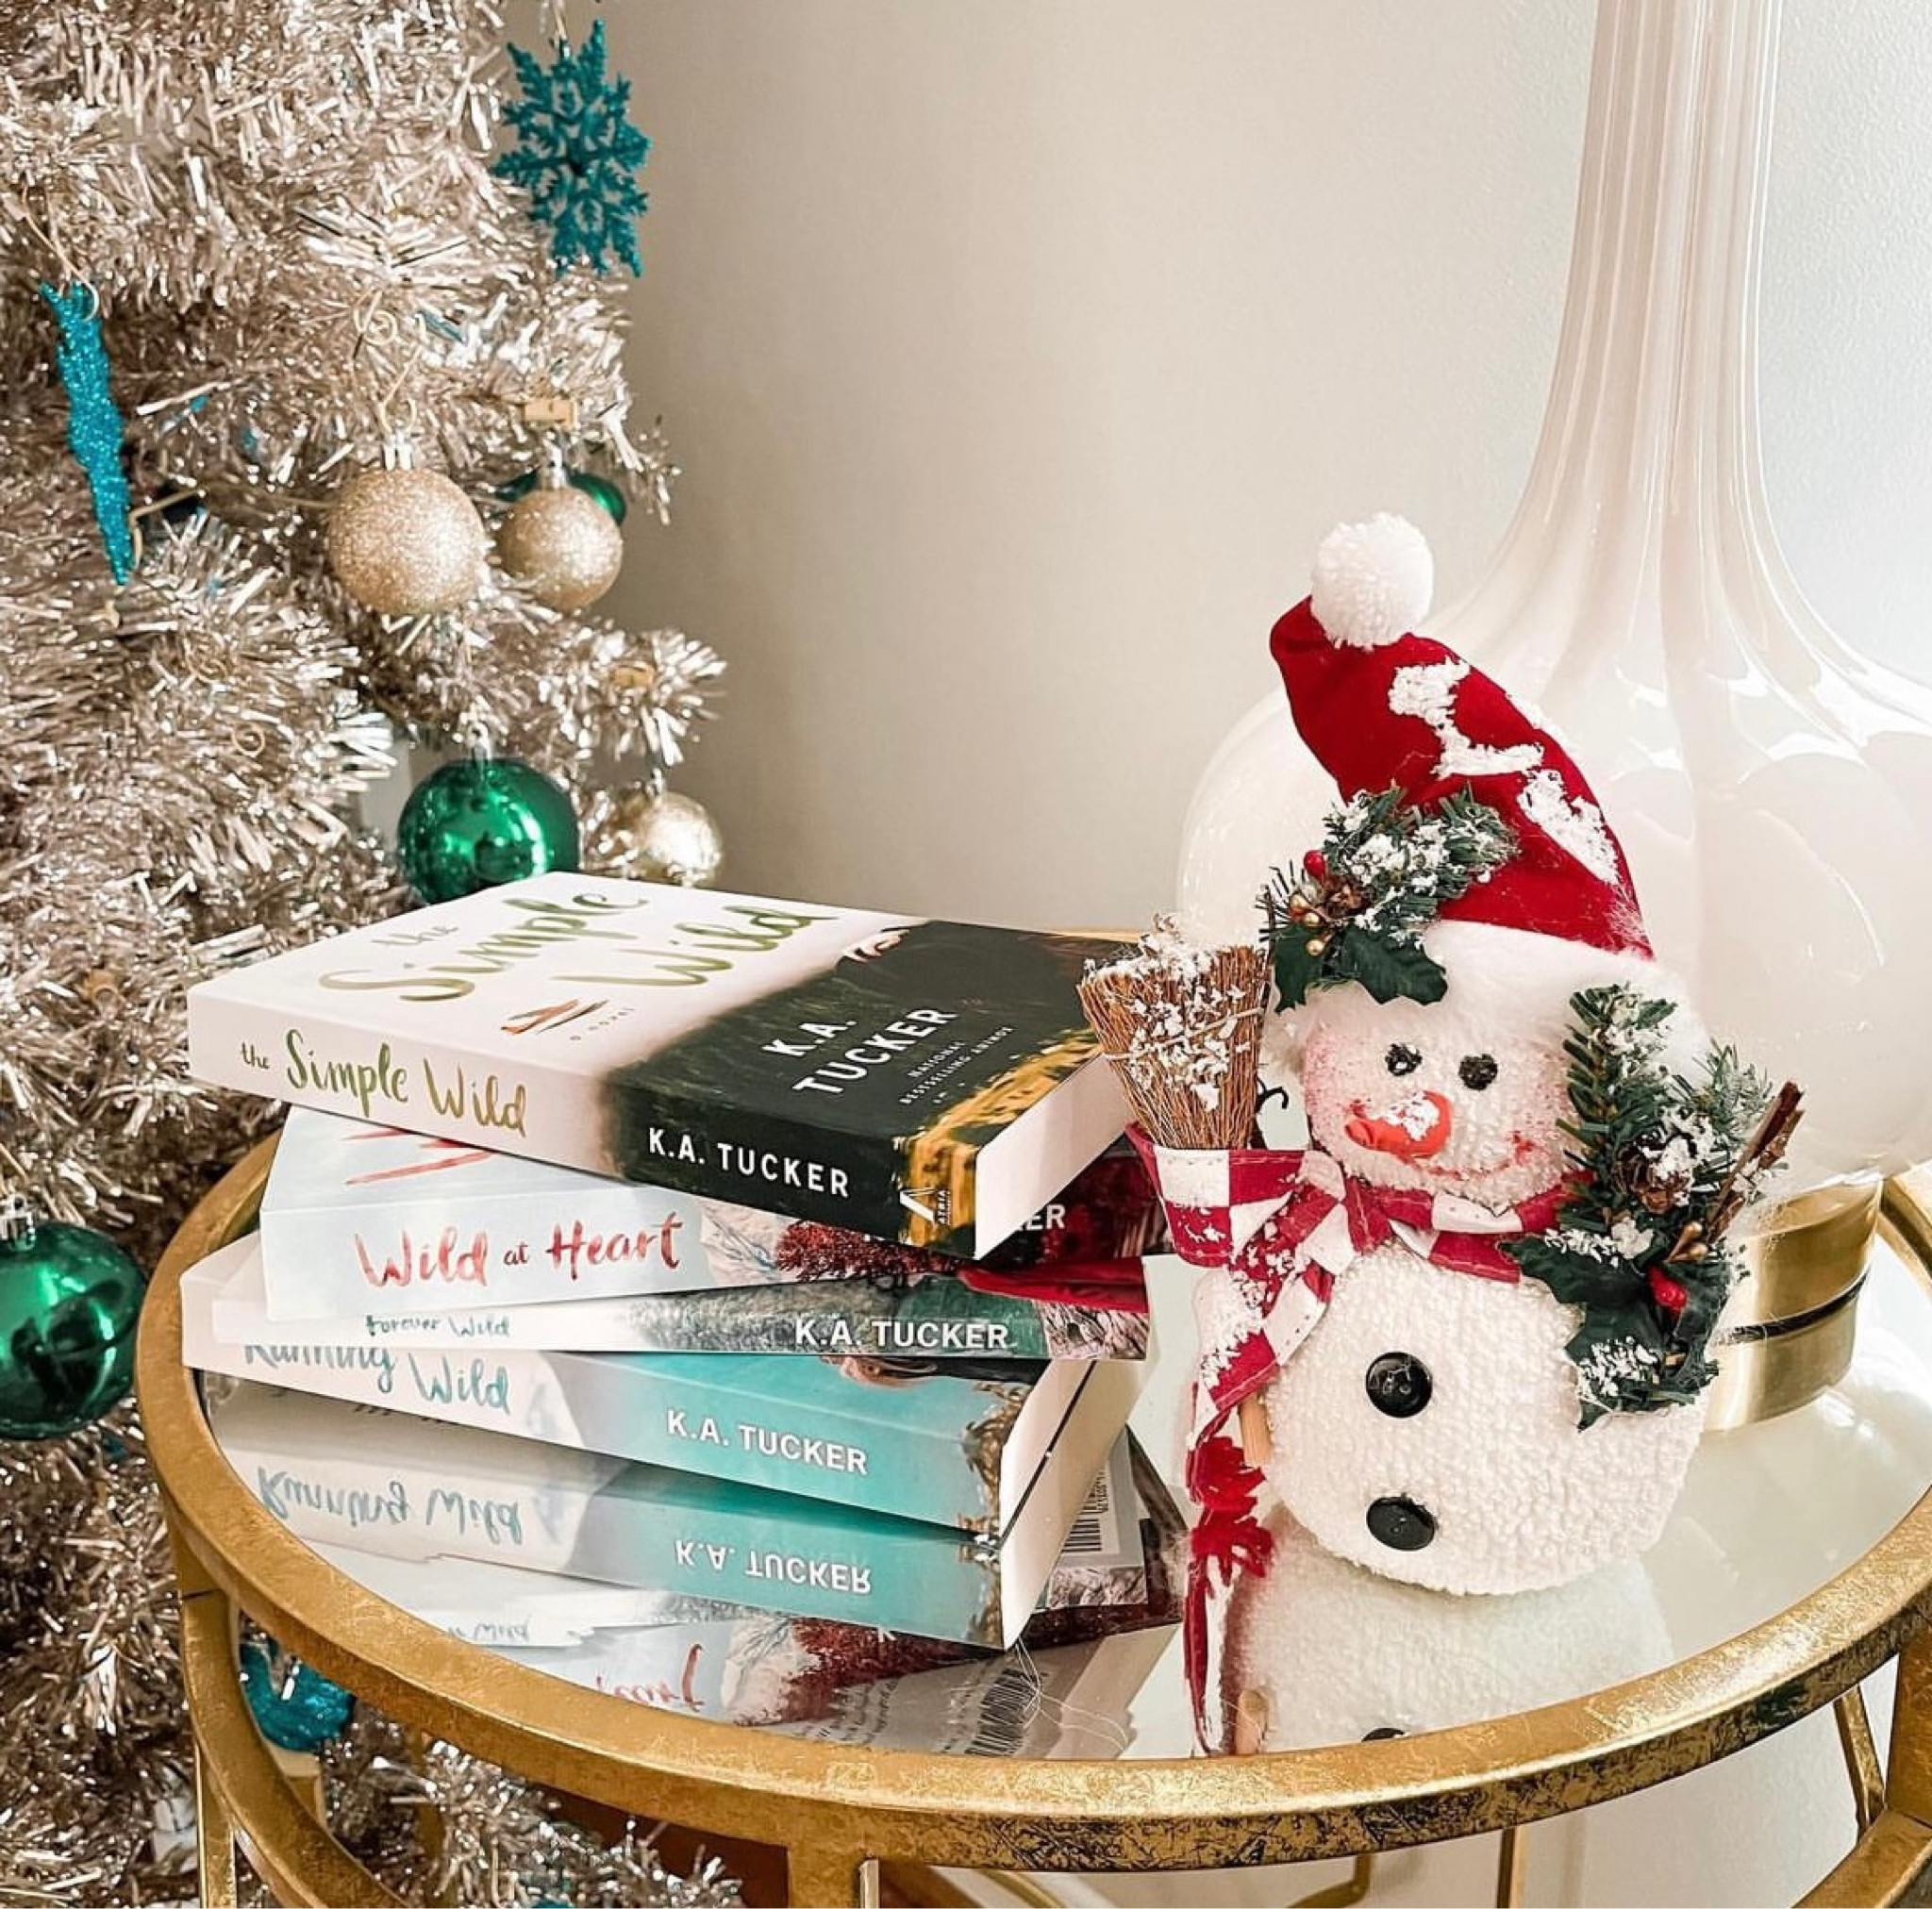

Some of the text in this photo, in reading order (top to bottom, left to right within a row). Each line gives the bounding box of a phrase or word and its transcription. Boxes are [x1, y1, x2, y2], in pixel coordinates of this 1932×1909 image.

[318, 892, 648, 1002] Simple
[550, 905, 839, 987] Wild
[761, 1020, 858, 1057] K.A.
[791, 1008, 958, 1094] TUCKER
[908, 1041, 965, 1078] NATIONAL
[242, 1028, 526, 1137] the Simple Wild
[648, 1127, 849, 1199] K.A. TUCKER
[355, 1211, 683, 1286] Wild at Heart
[448, 1316, 509, 1337] Wild
[795, 1319, 1009, 1349] K.A. TUCKER
[408, 1352, 510, 1416] Wild
[666, 1408, 868, 1476] K.A. TUCKER
